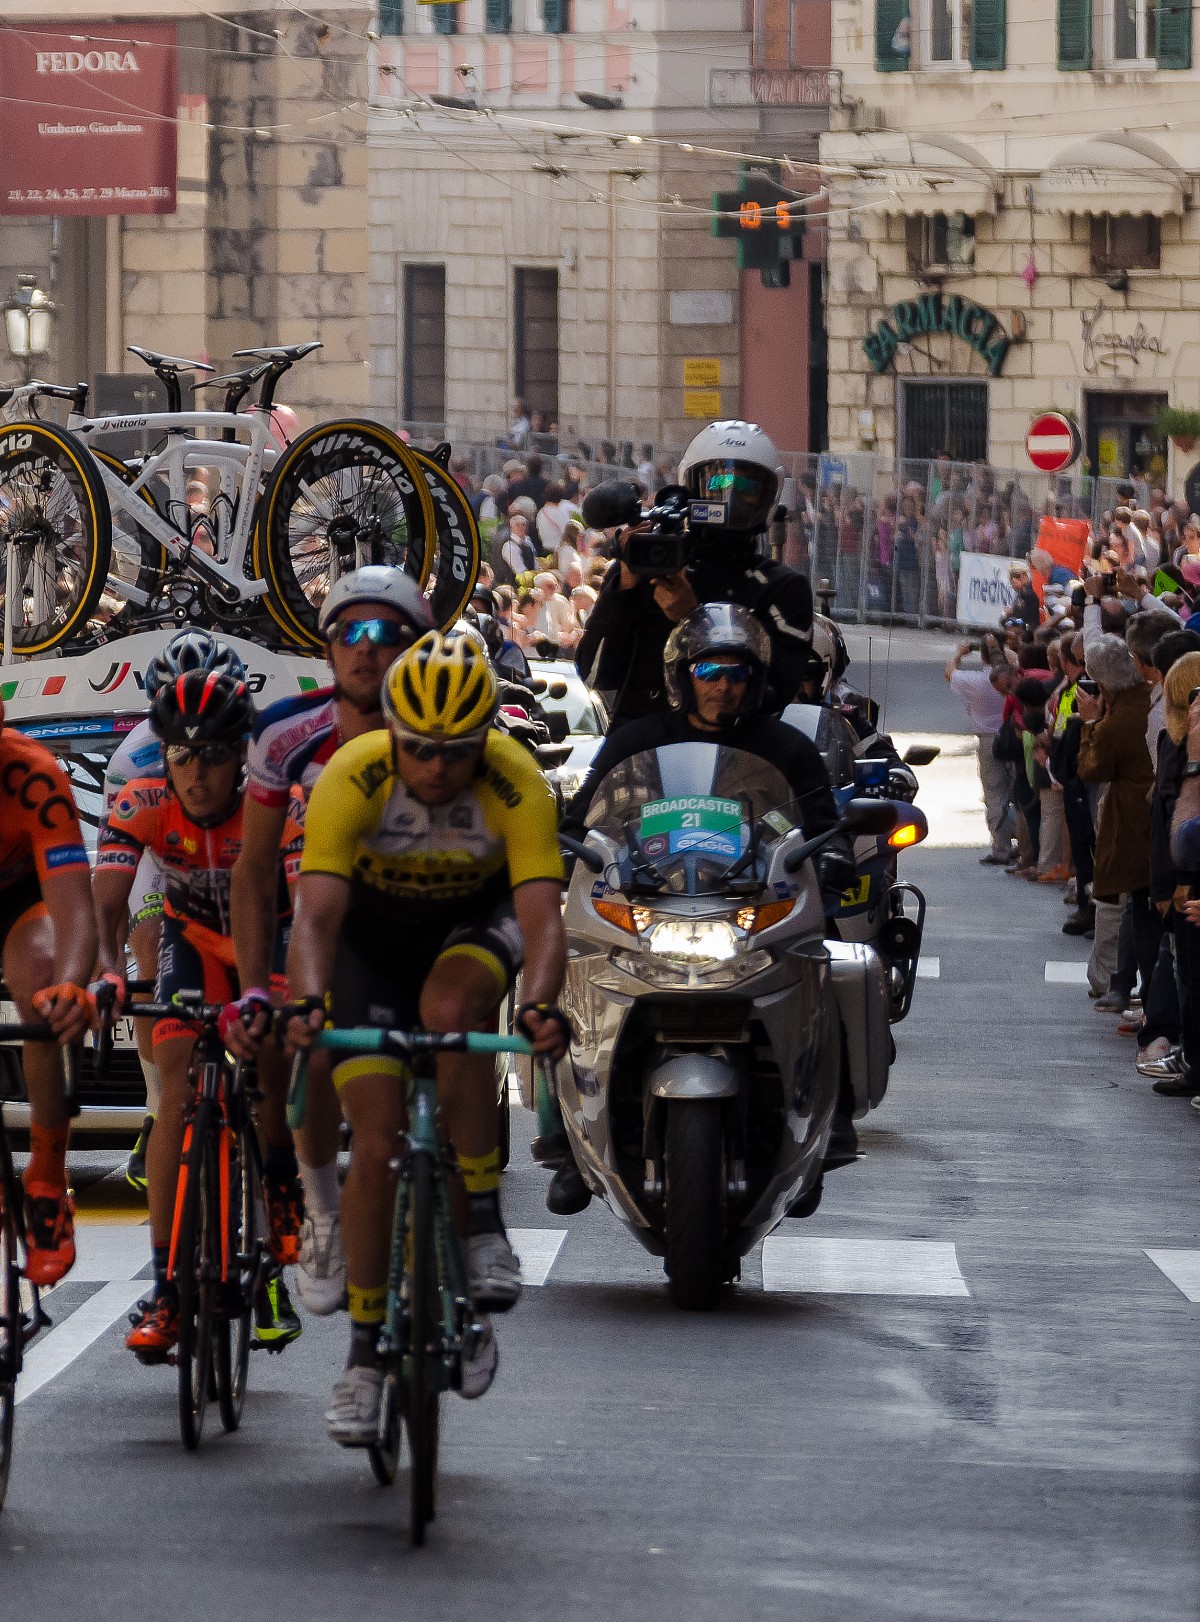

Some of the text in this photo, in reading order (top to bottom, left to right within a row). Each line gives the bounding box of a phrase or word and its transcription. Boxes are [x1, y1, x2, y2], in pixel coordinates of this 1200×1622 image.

[36, 51, 139, 72] FEDORA
[38, 121, 143, 134] Umberto Giordano
[114, 185, 148, 198] Marzo
[863, 291, 1011, 378] FARMACIA
[111, 418, 147, 429] vittoria
[719, 438, 747, 446] Arai
[312, 433, 414, 495] vittoria
[693, 508, 721, 518] Rai HD
[25, 724, 102, 736] engie
[2, 760, 75, 829] CCC
[643, 799, 739, 818] BROADCASTER
[681, 813, 699, 827] 21
